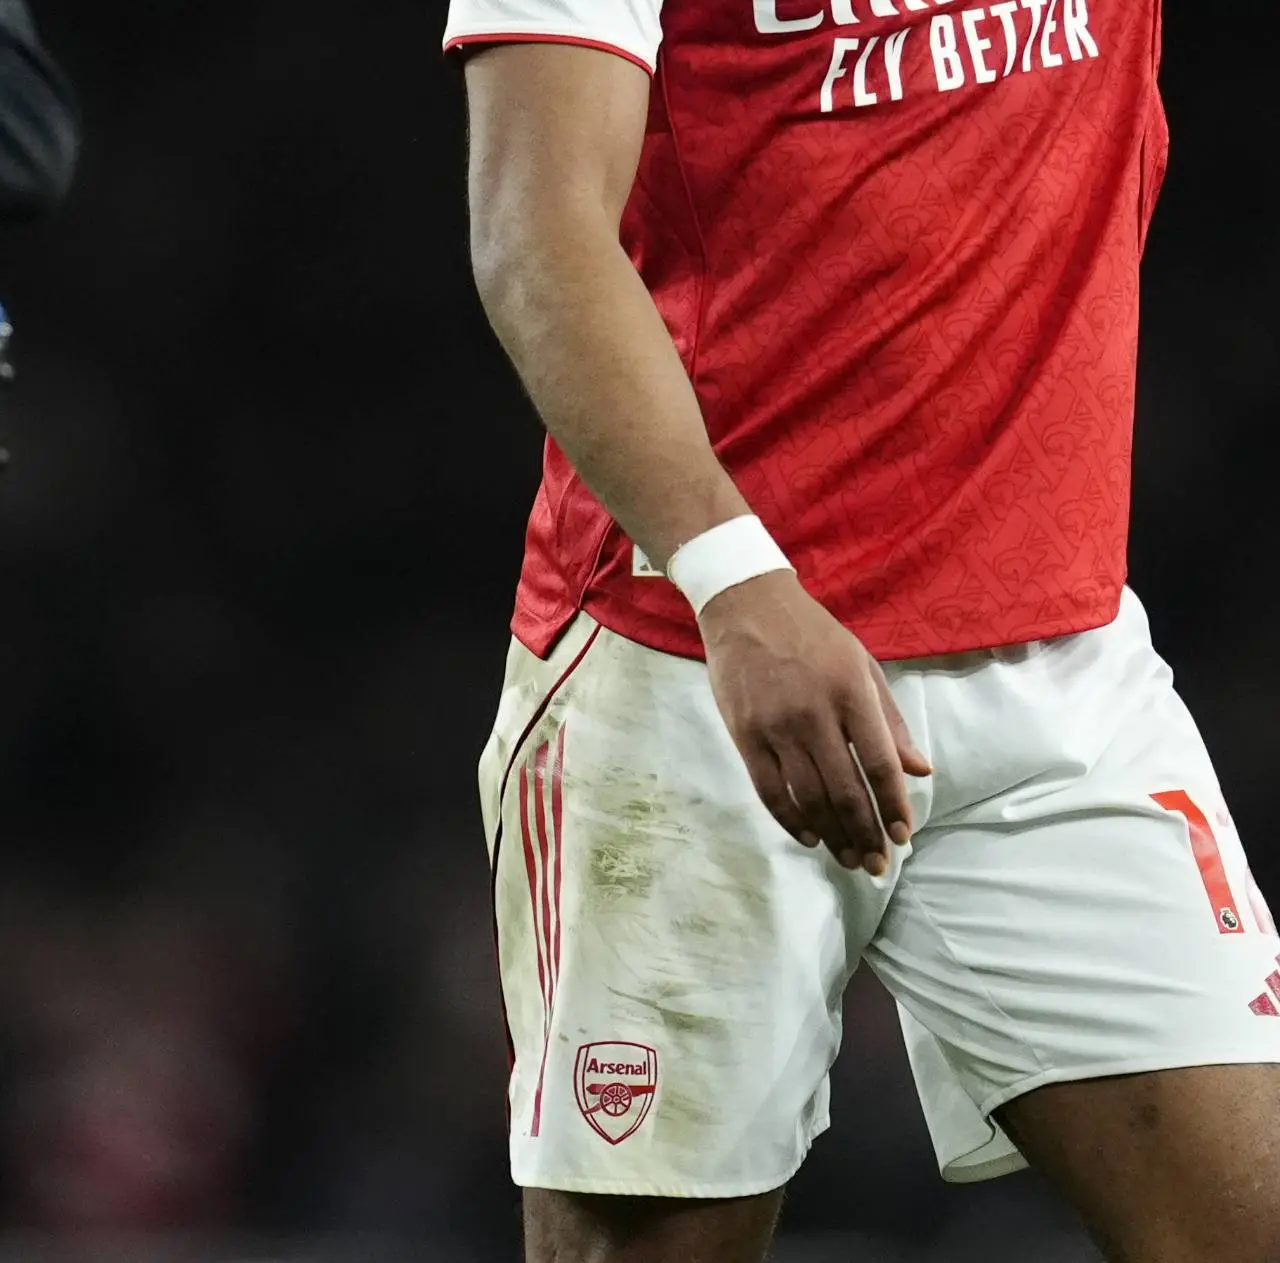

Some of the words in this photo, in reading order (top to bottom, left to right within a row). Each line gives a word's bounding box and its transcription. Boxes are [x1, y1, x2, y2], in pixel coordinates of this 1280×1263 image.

[819, 27, 911, 112] FLY
[1149, 789, 1273, 935] 1
[586, 1057, 647, 1076] Arsenal
